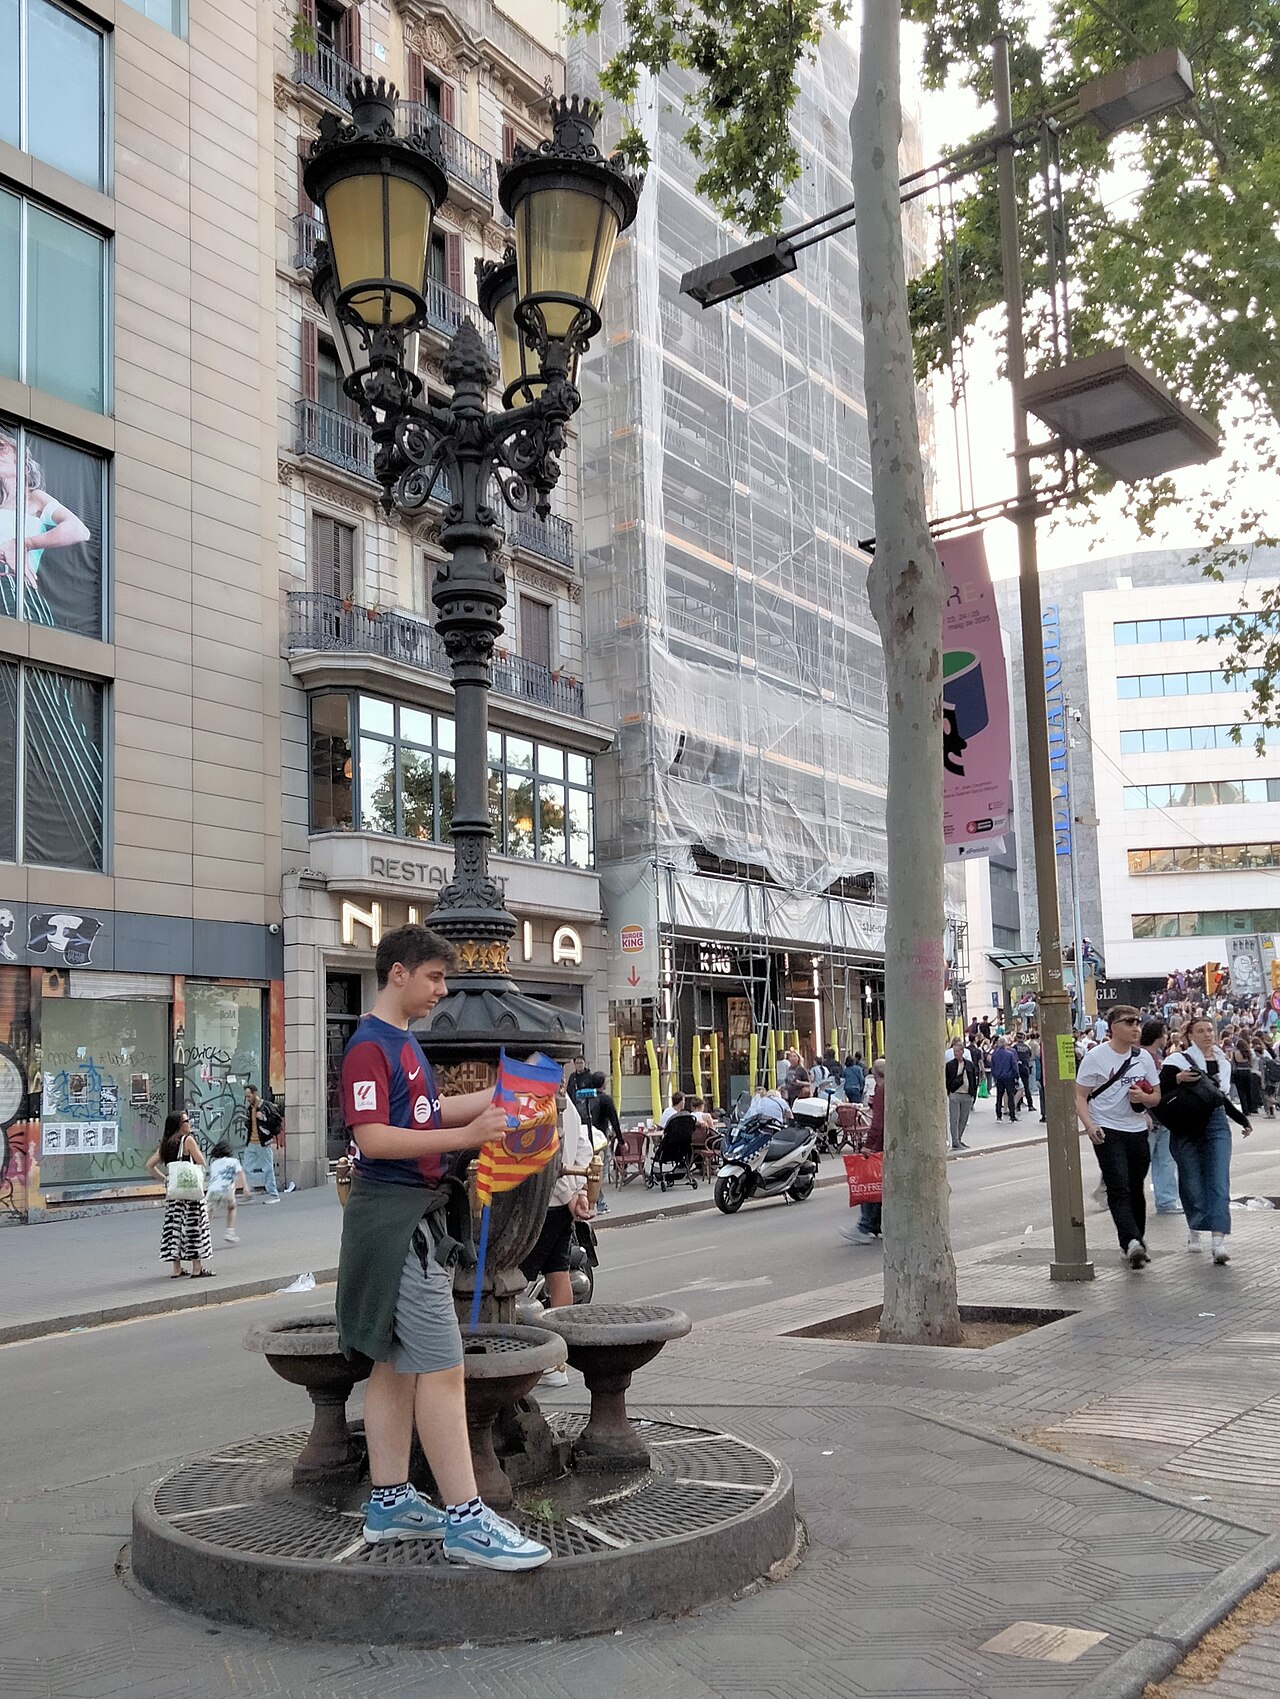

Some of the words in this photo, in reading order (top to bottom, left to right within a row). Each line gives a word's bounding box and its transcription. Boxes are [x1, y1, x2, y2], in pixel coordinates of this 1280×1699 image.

[370, 855, 509, 890] RESTANT
[340, 898, 584, 967] NIA
[621, 931, 644, 939] BURGER
[622, 938, 644, 947] KING
[700, 952, 731, 973] KNG
[1095, 987, 1118, 1000] GLE
[850, 1183, 867, 1193] DUTY
[867, 1181, 883, 1191] FRE
